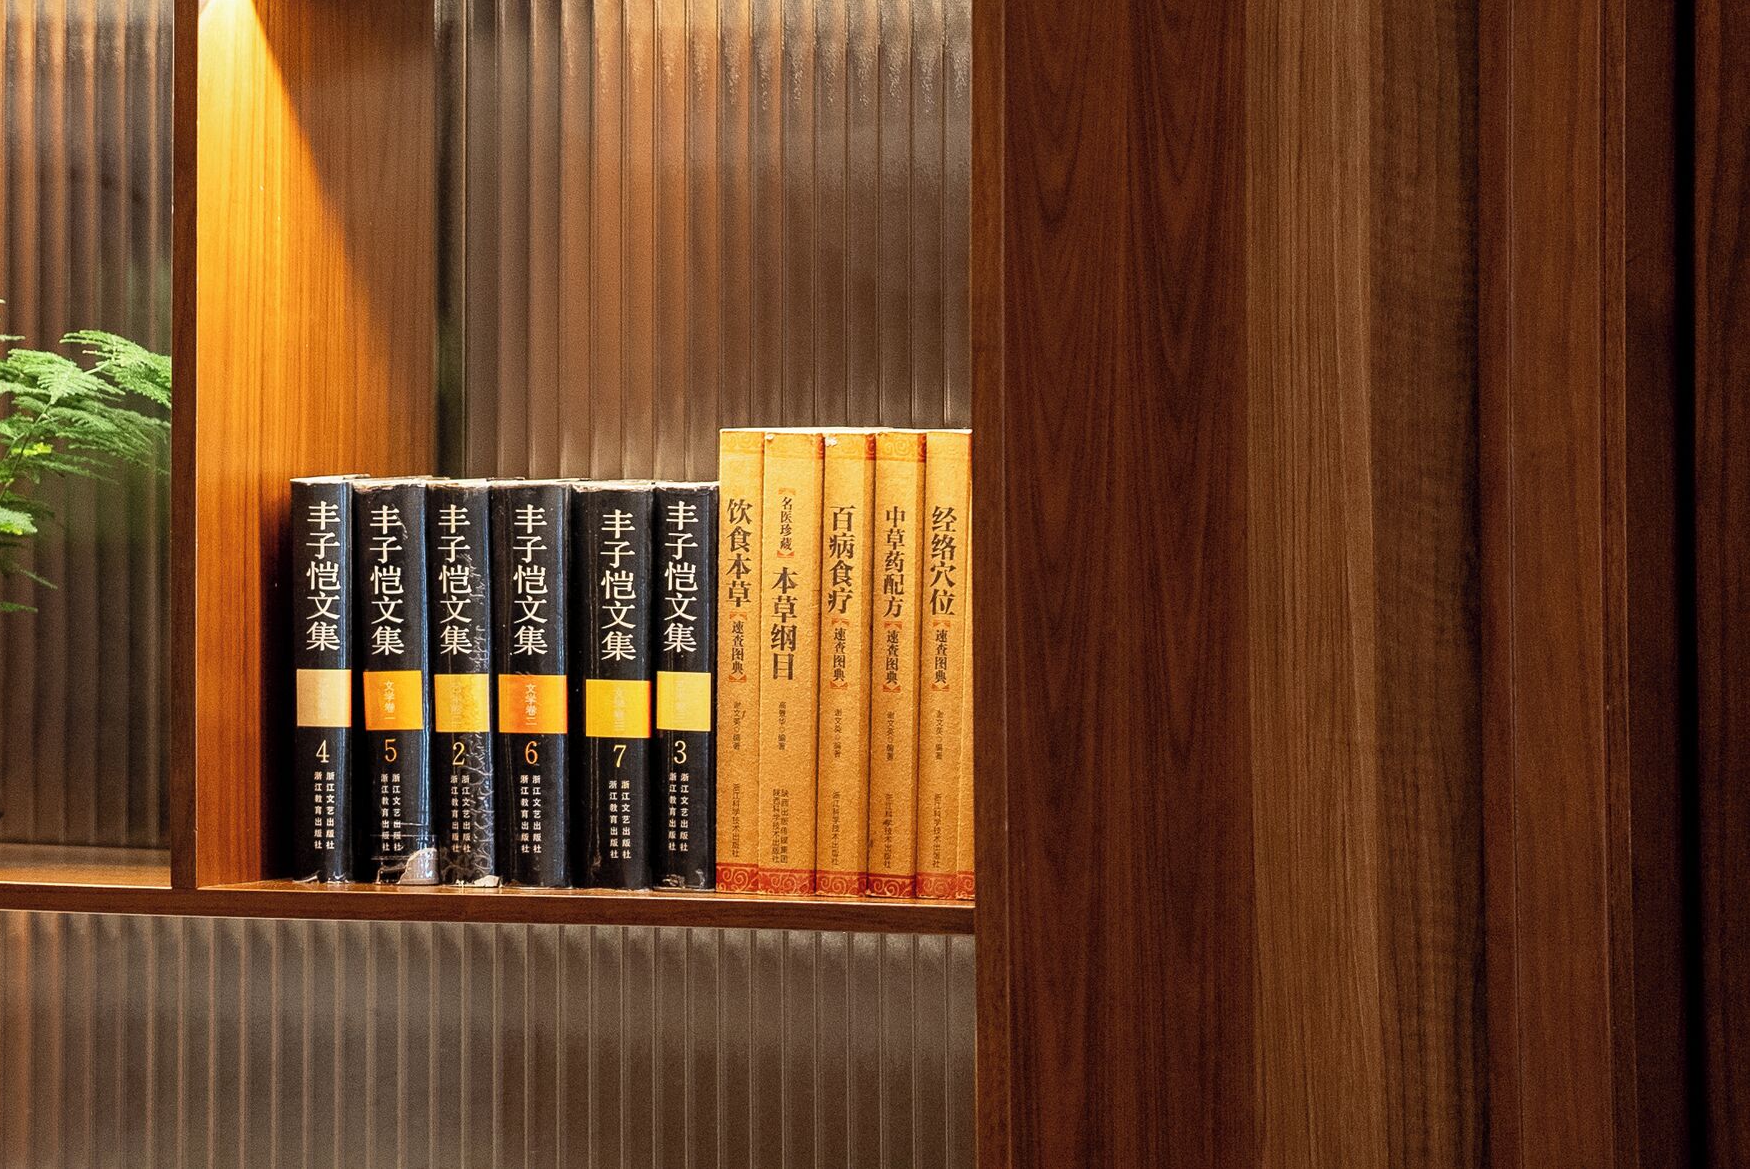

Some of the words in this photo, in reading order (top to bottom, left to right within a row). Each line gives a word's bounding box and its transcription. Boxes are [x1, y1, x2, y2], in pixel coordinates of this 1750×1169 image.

[306, 500, 341, 652] 丰子恺文集
[369, 504, 405, 656] 丰子恺文集
[438, 503, 473, 656] 丰子恺文集
[512, 503, 548, 656] 丰子恺文集
[601, 509, 637, 662] 丰子恺文集
[664, 500, 698, 654] 丰子恺文集
[725, 497, 753, 608] 饮食本草
[827, 504, 856, 615] 百病食疗
[883, 504, 906, 619] 中草药配方
[928, 505, 958, 617] 经络穴位
[770, 566, 798, 681] 本草纲目
[384, 680, 395, 720] 文学卷一
[525, 684, 538, 726] 文学卷二
[315, 739, 330, 764] 4
[384, 738, 398, 763] 5
[452, 741, 466, 766] 2
[524, 740, 539, 765] 6
[613, 744, 627, 768] 7
[673, 740, 687, 764] 3
[314, 771, 323, 849] 浙江教育出版社
[326, 771, 335, 850] 浙江文艺出版社
[380, 773, 390, 852] 浙江教育出版社
[392, 773, 401, 852] 浙江文艺出版社
[450, 774, 460, 853] 浙江教育出版社
[462, 774, 471, 853] 浙江文艺出版社
[520, 774, 530, 853] 浙江教育出版社
[532, 774, 542, 853] 浙江文艺出版社
[608, 780, 619, 859] 浙江教育出版社
[621, 780, 632, 859] 浙江文艺出版社
[668, 772, 677, 851] 浙江教育出版社
[680, 773, 690, 852] 浙江文艺出版社
